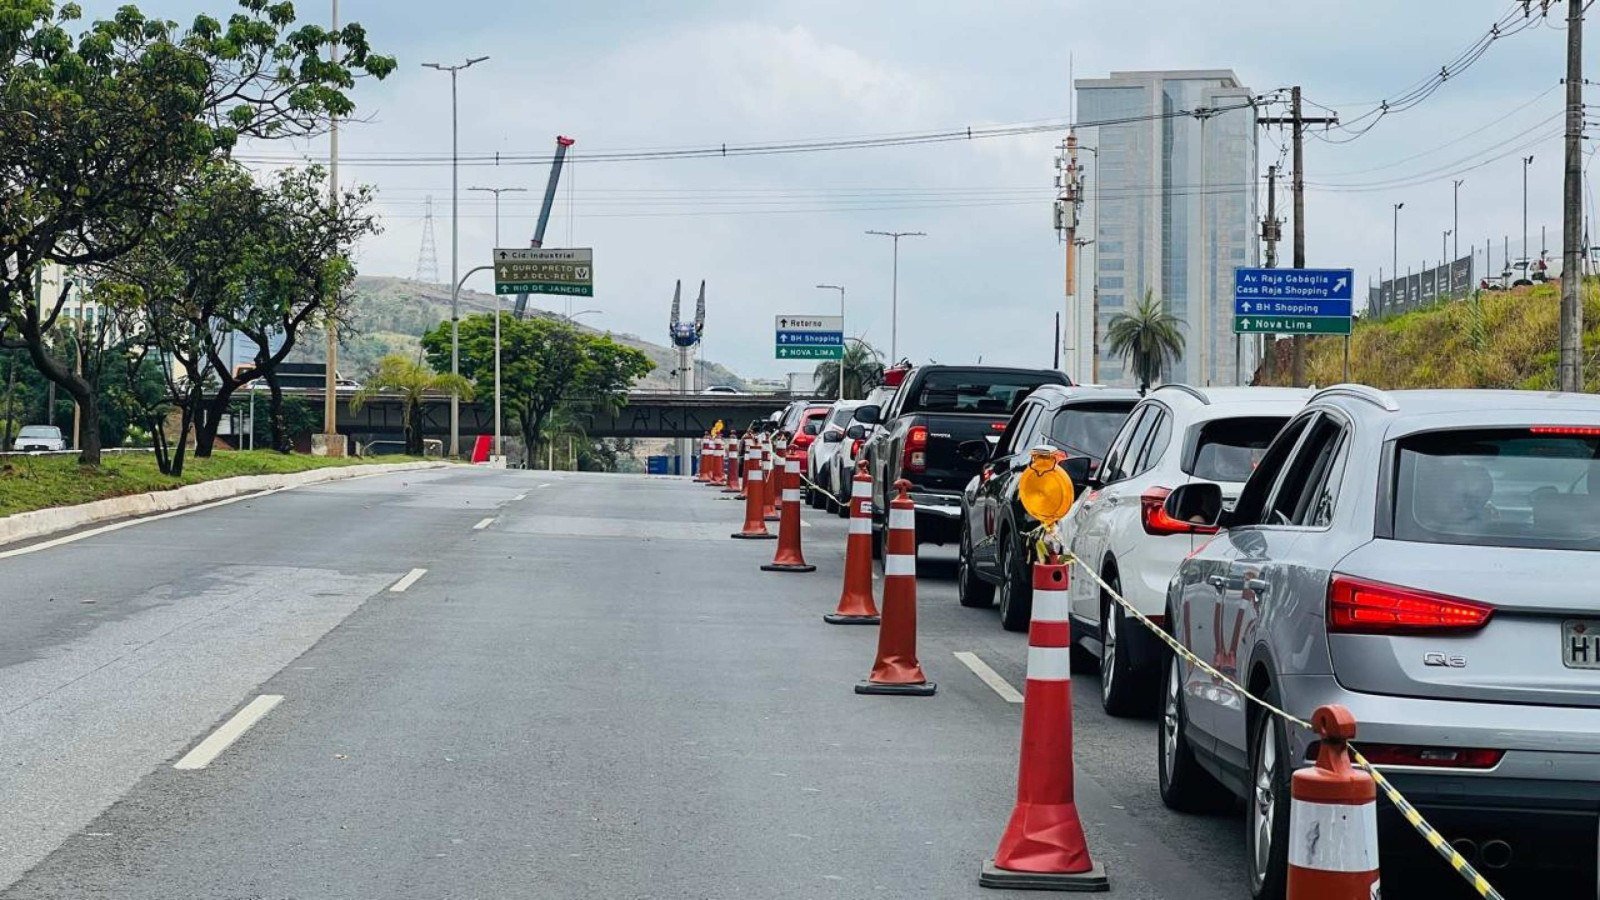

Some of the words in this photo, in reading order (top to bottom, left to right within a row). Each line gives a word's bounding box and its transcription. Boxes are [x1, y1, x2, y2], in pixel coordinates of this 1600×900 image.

[541, 264, 573, 272] PRETO
[1244, 274, 1258, 283] Av.
[1261, 274, 1283, 285] Raja
[1285, 274, 1328, 285] Gabáglia
[548, 286, 588, 294] JANEIRO
[1261, 286, 1283, 295] Raja
[1285, 286, 1328, 297] Shopping
[1256, 303, 1271, 311] BH
[1274, 303, 1319, 314] Shopping
[790, 319, 823, 327] Retorno
[1255, 319, 1283, 329] Nova
[1285, 319, 1312, 329] Lima
[790, 334, 802, 342] BH
[804, 334, 840, 343] Shopping
